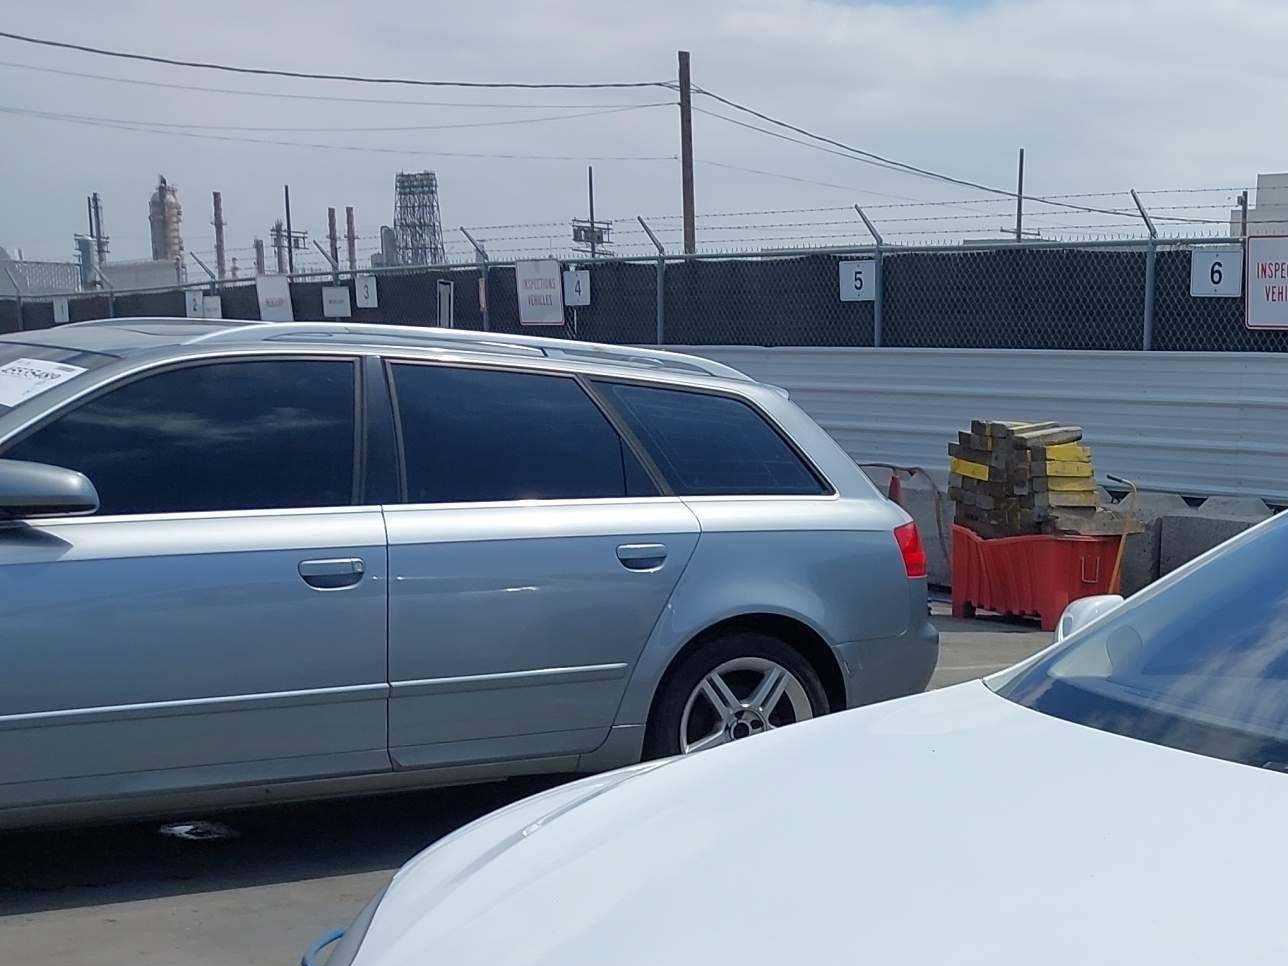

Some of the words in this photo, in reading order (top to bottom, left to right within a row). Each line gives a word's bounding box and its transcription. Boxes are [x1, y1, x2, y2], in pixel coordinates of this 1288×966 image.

[854, 270, 863, 290] 5
[1210, 261, 1223, 285] 6
[363, 283, 370, 300] 3
[575, 280, 581, 297] 4
